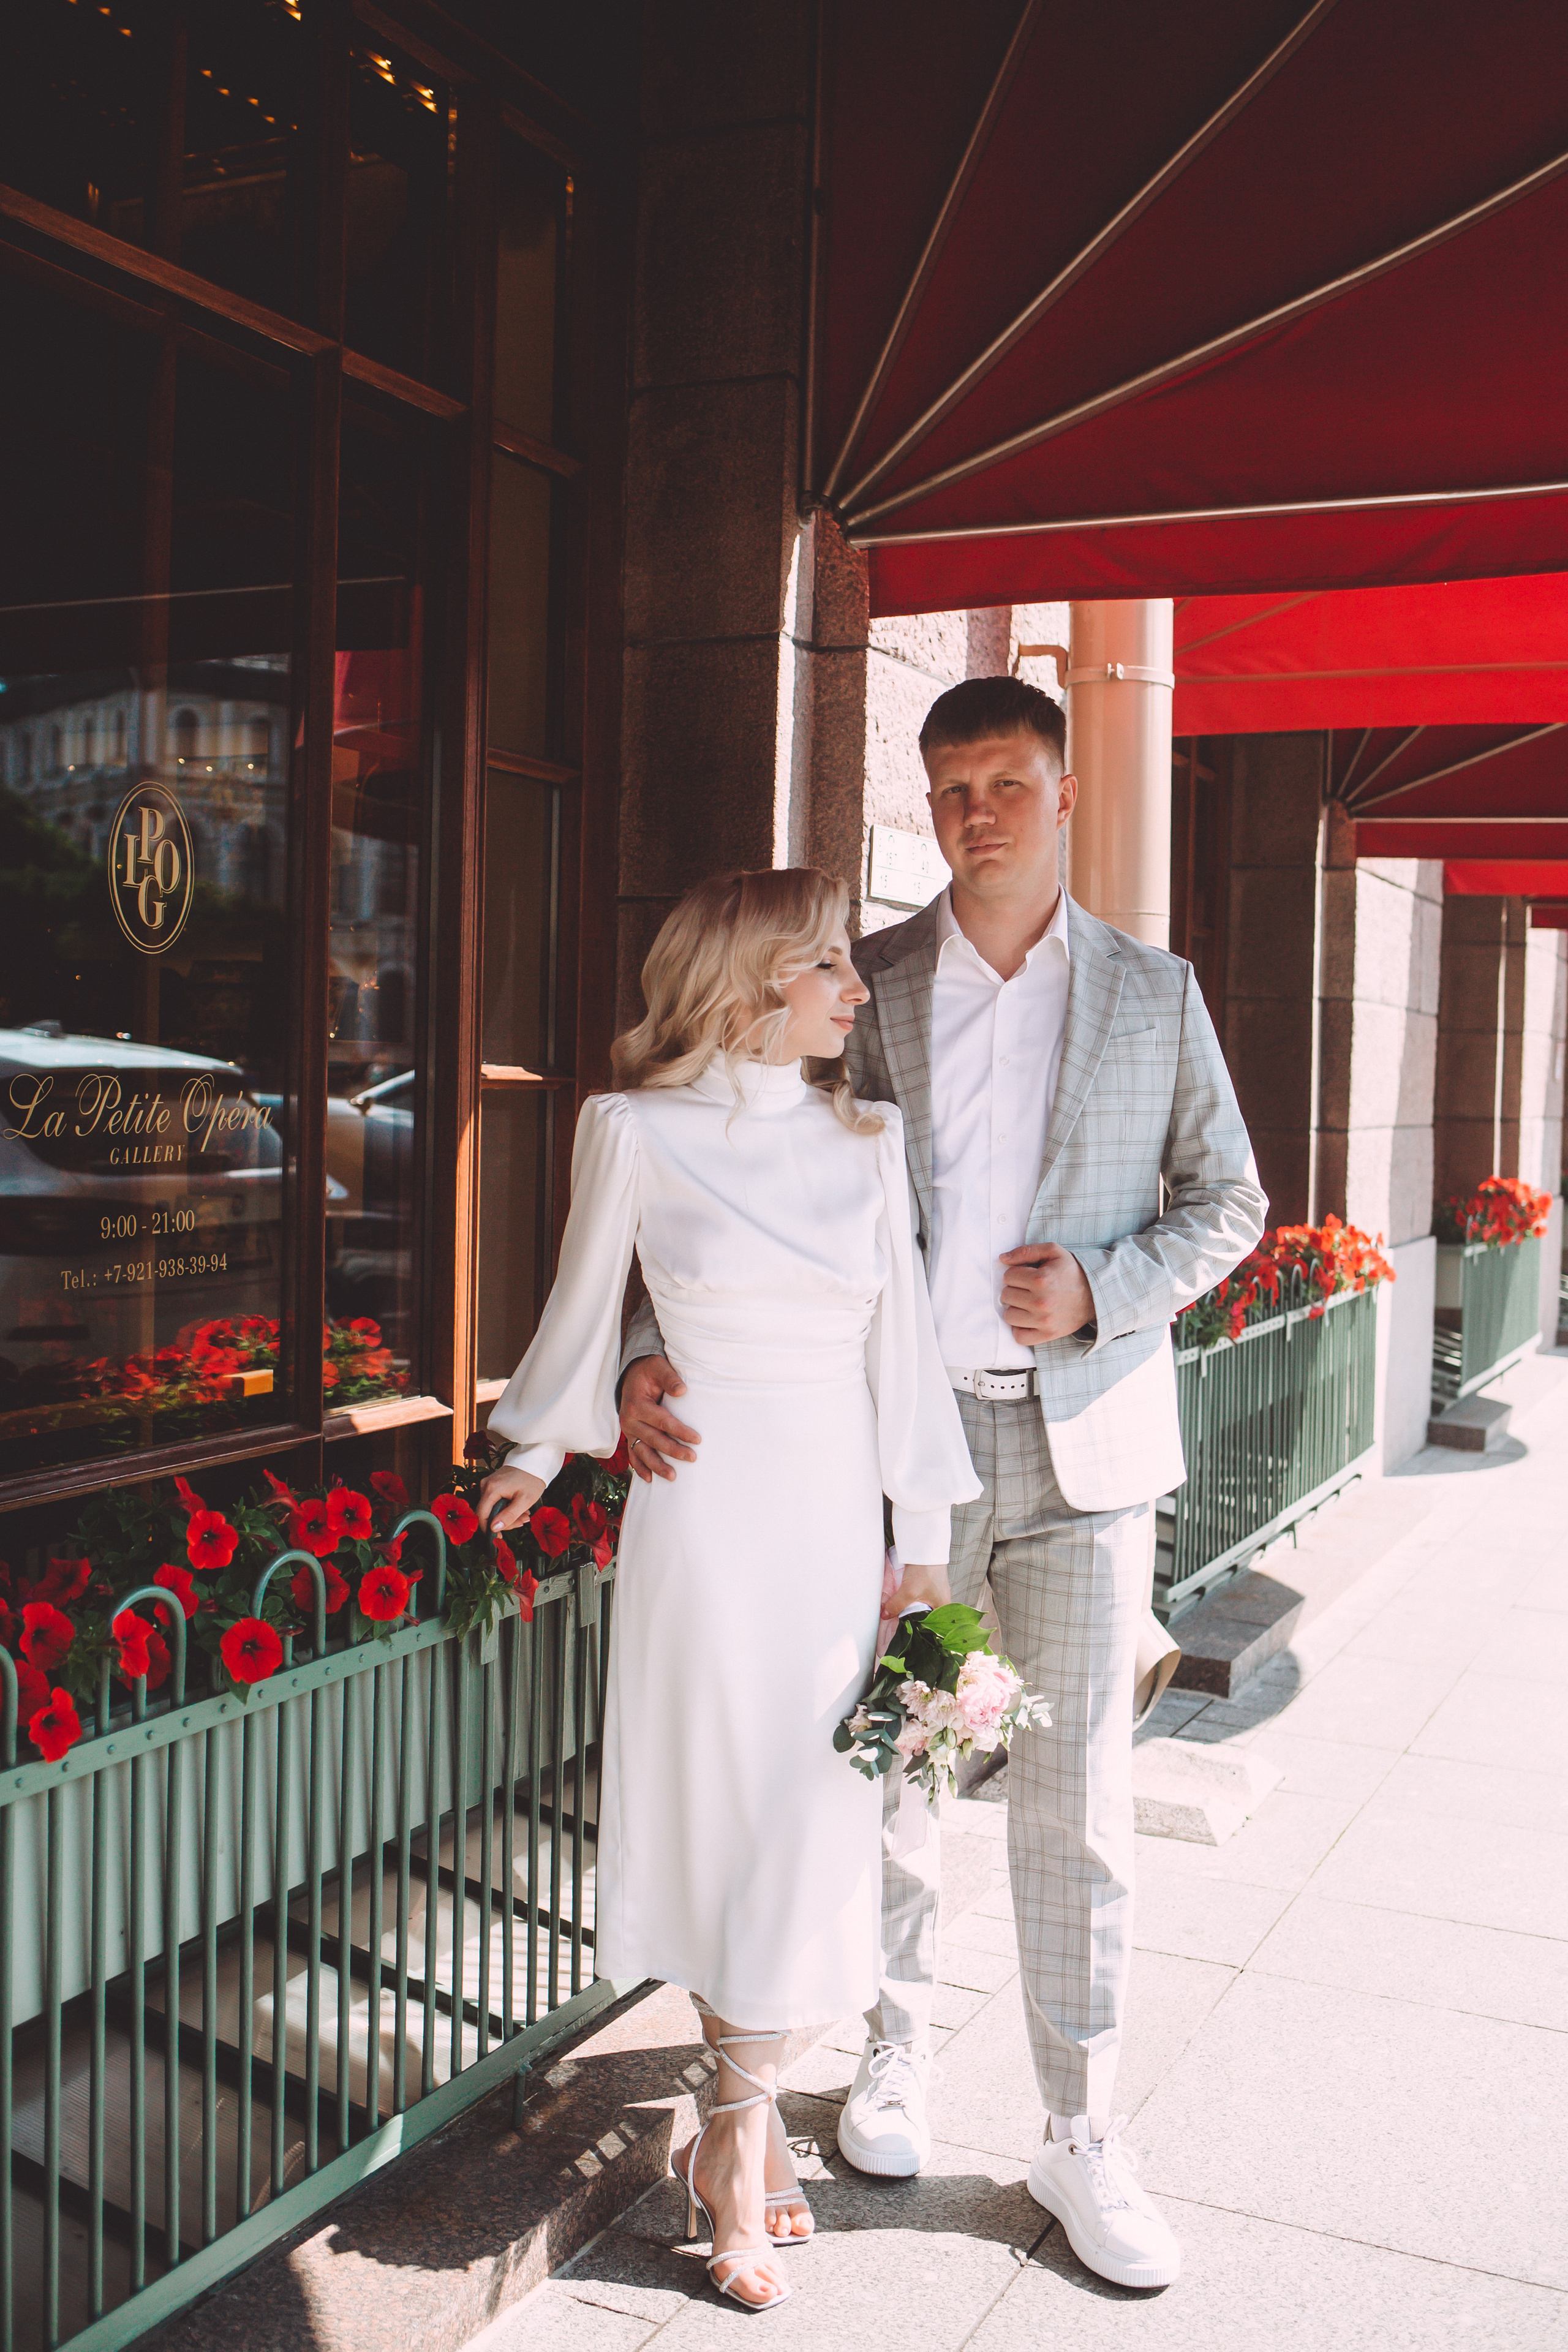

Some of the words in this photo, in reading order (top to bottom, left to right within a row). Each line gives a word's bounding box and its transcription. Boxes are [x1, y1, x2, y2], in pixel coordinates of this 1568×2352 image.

[4, 1073, 67, 1139] La
[75, 1073, 172, 1137] Petite
[179, 1073, 273, 1153] Opéra
[110, 1144, 186, 1165] GALLERY
[100, 1215, 137, 1239] 9:00
[151, 1209, 195, 1235] 21:00
[61, 1270, 97, 1290] Tel.:
[104, 1252, 227, 1284] +7-921-938-39-94
